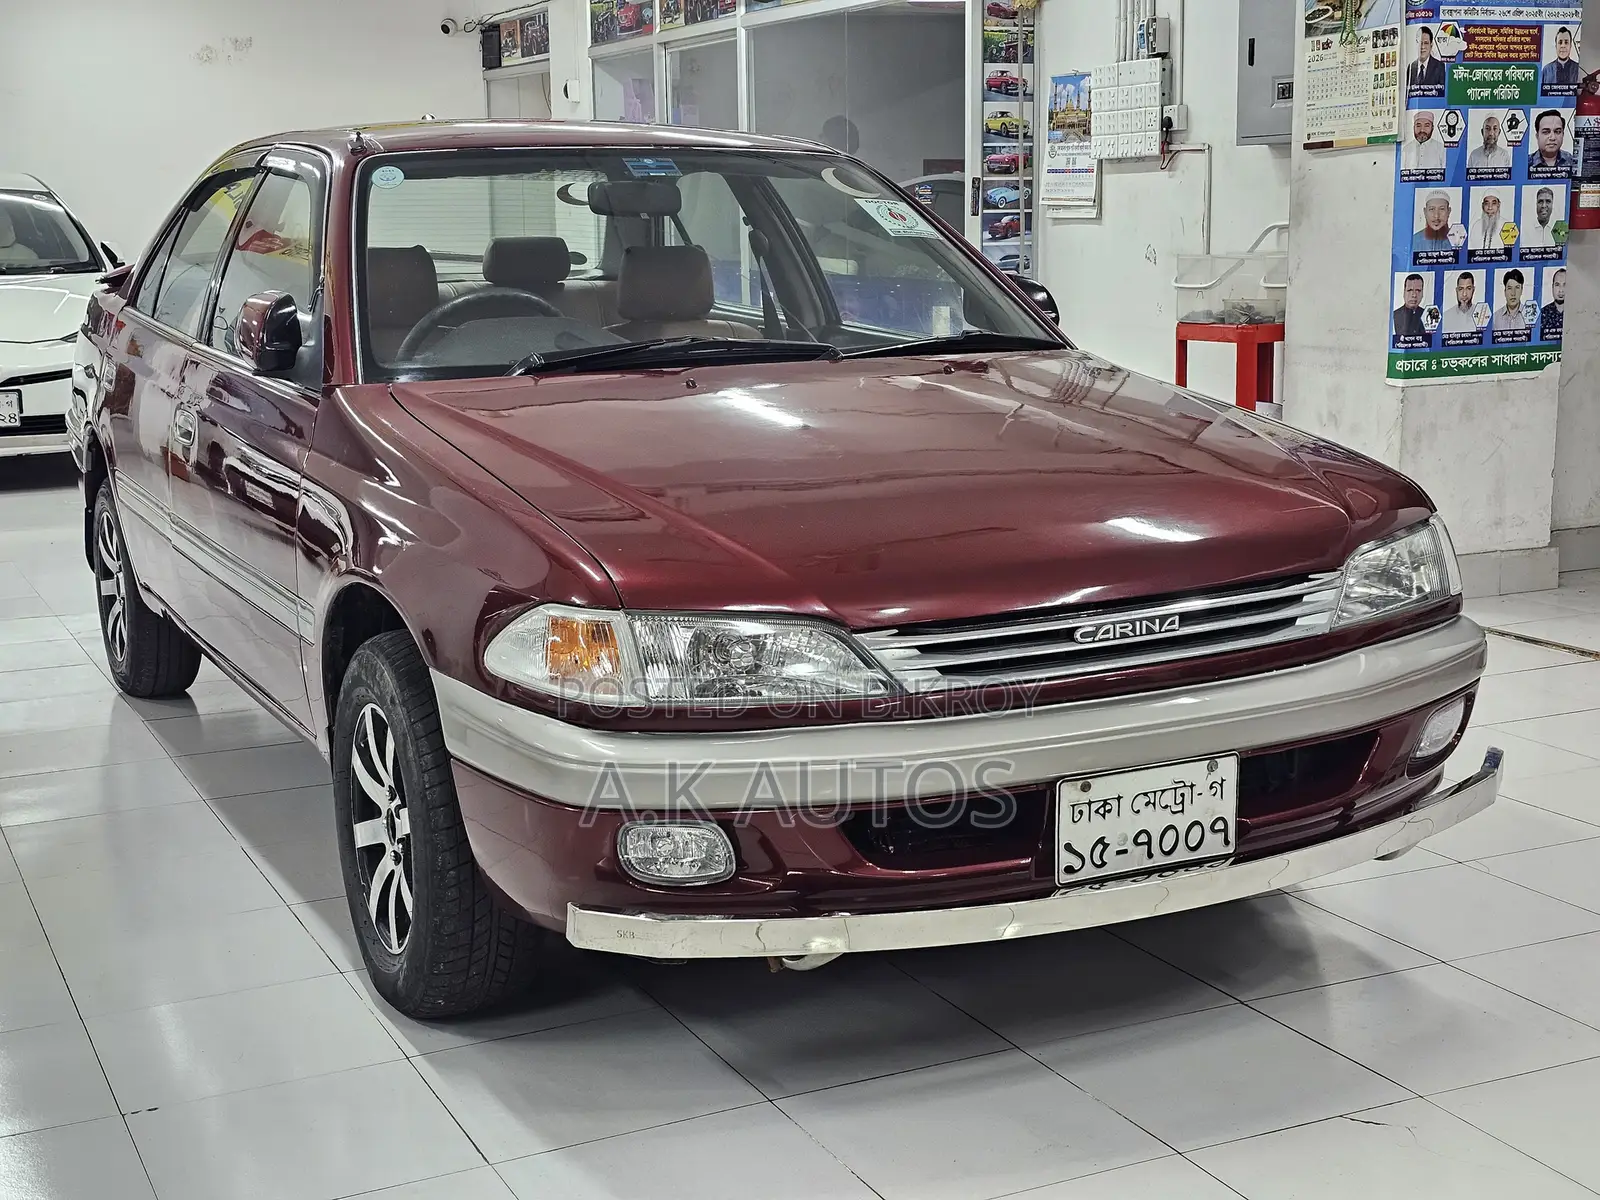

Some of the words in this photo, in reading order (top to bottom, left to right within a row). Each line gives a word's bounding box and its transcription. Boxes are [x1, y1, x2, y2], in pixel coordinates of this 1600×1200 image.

[1307, 53, 1324, 63] 2026
[1505, 65, 1535, 81] পরিষদের
[1467, 87, 1491, 100] প্যানেল
[1493, 84, 1520, 100] পরিচিতি
[1396, 359, 1428, 372] প্রচারে
[1491, 352, 1528, 366] সাধারণ
[1073, 614, 1180, 644] CARINA
[1070, 794, 1124, 824] ঢাকা
[1063, 816, 1231, 875] ১৫-৭০০৭
[616, 929, 635, 940] SKB
